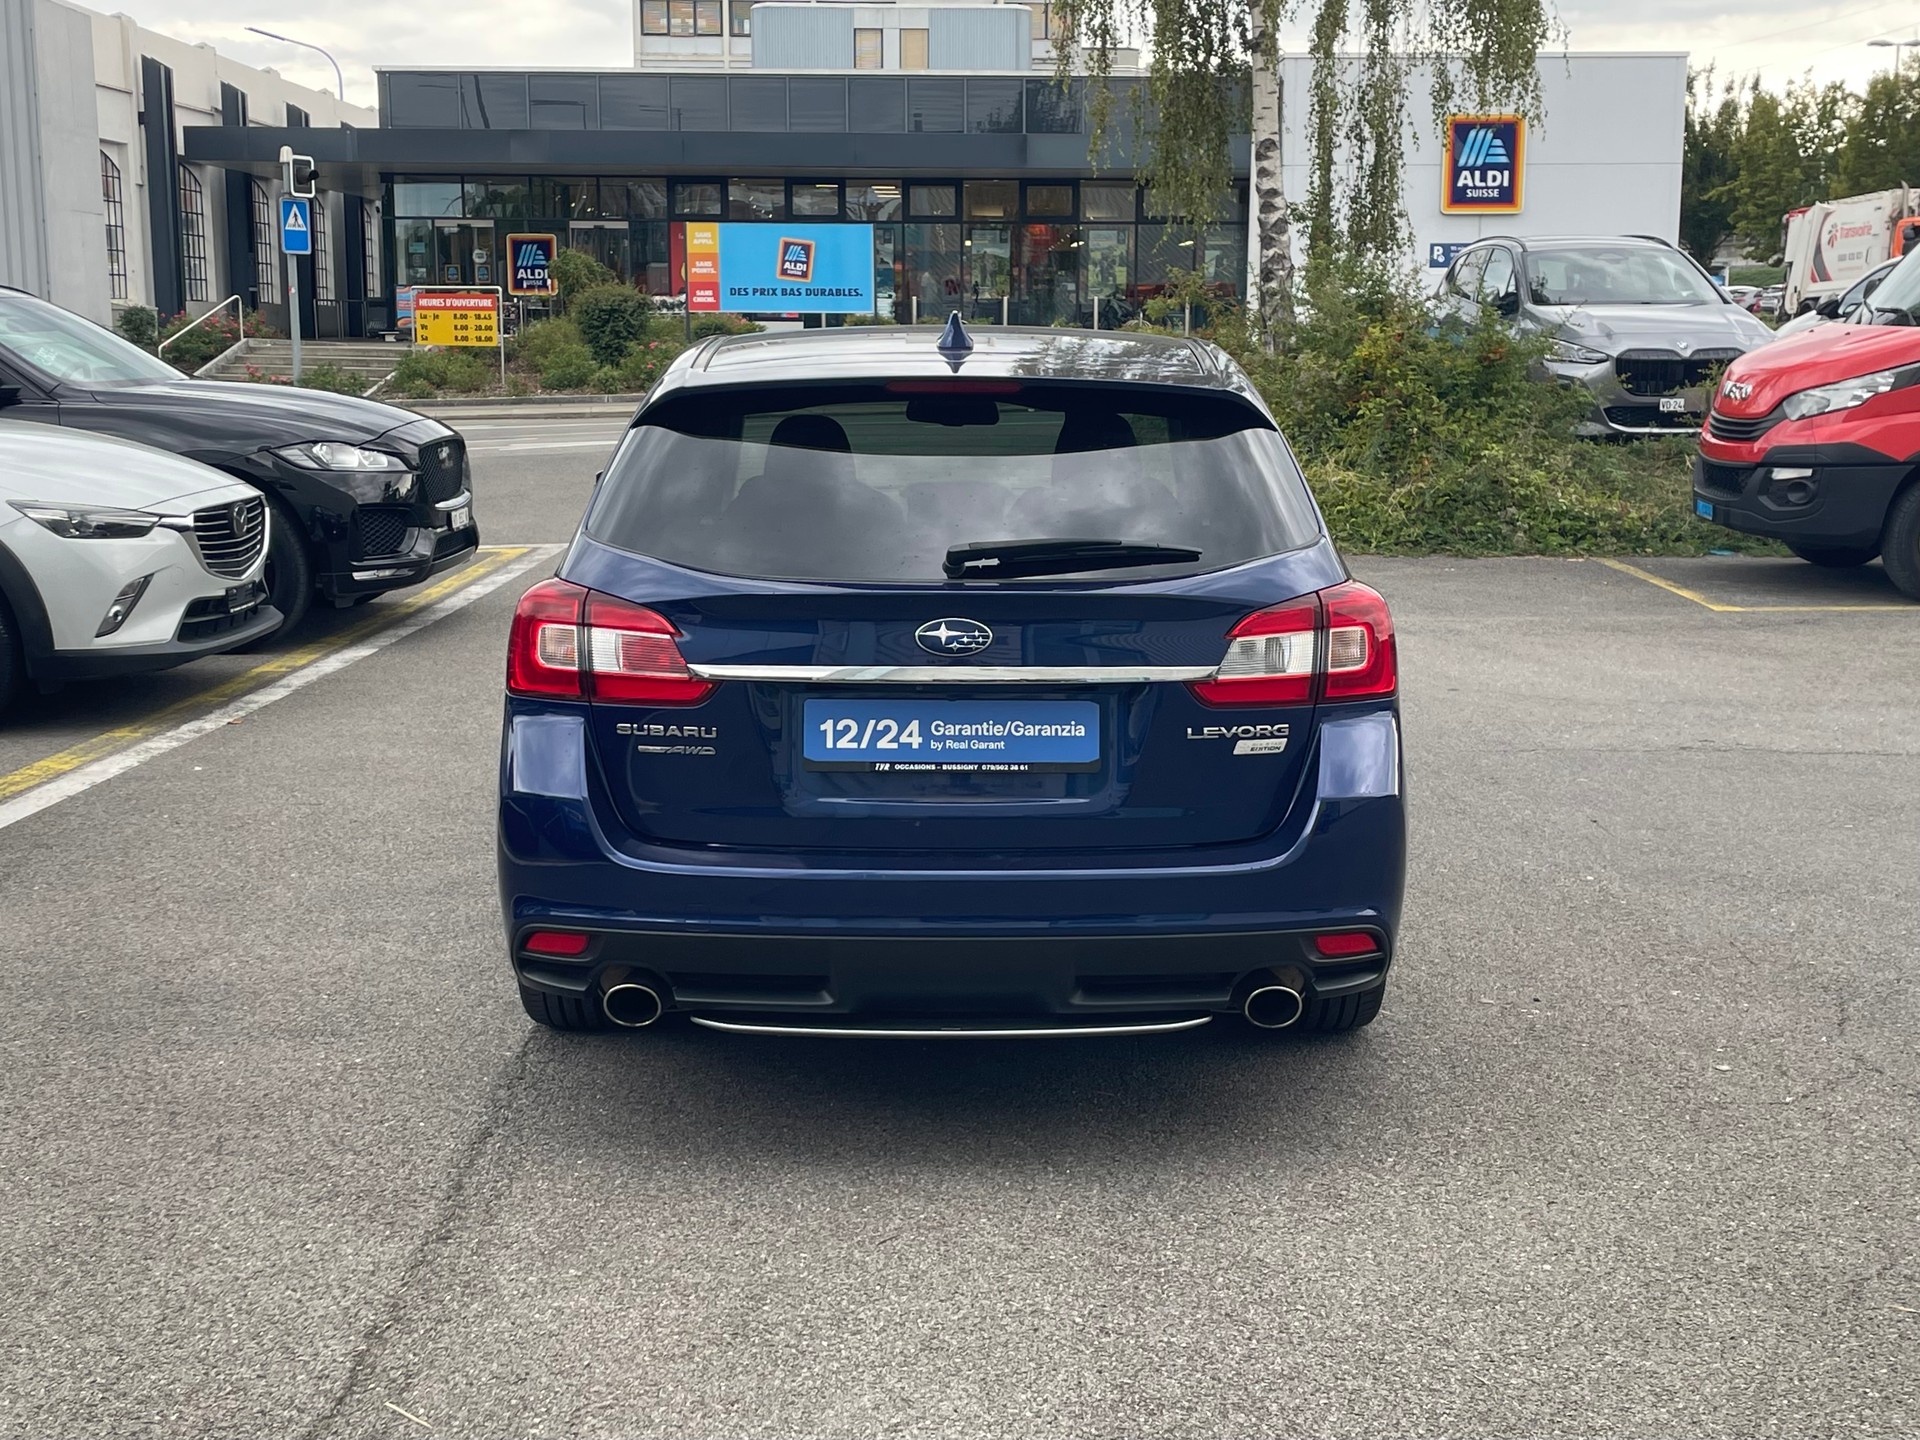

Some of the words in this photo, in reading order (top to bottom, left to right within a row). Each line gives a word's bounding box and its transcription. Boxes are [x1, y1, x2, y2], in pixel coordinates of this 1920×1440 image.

[1457, 170, 1510, 187] ALDI
[1466, 188, 1500, 198] SUISSE
[783, 261, 807, 272] ALDI
[517, 268, 549, 279] ALDI
[730, 287, 749, 296] DES
[752, 287, 778, 296] PRIX
[781, 287, 802, 297] BAS
[805, 287, 863, 297] DURABLES.
[419, 298, 445, 307] HEURES
[446, 298, 493, 307] D'OUVERTURE
[1661, 400, 1671, 408] VD
[616, 723, 717, 738] SUBARU
[819, 718, 922, 749] 12/24
[930, 720, 1085, 737] Garantie/Garanzia
[1186, 724, 1290, 740] LEVORG
[666, 745, 717, 755] AWD
[930, 739, 943, 751] by
[945, 739, 968, 750] Real
[970, 740, 1005, 750] Garant
